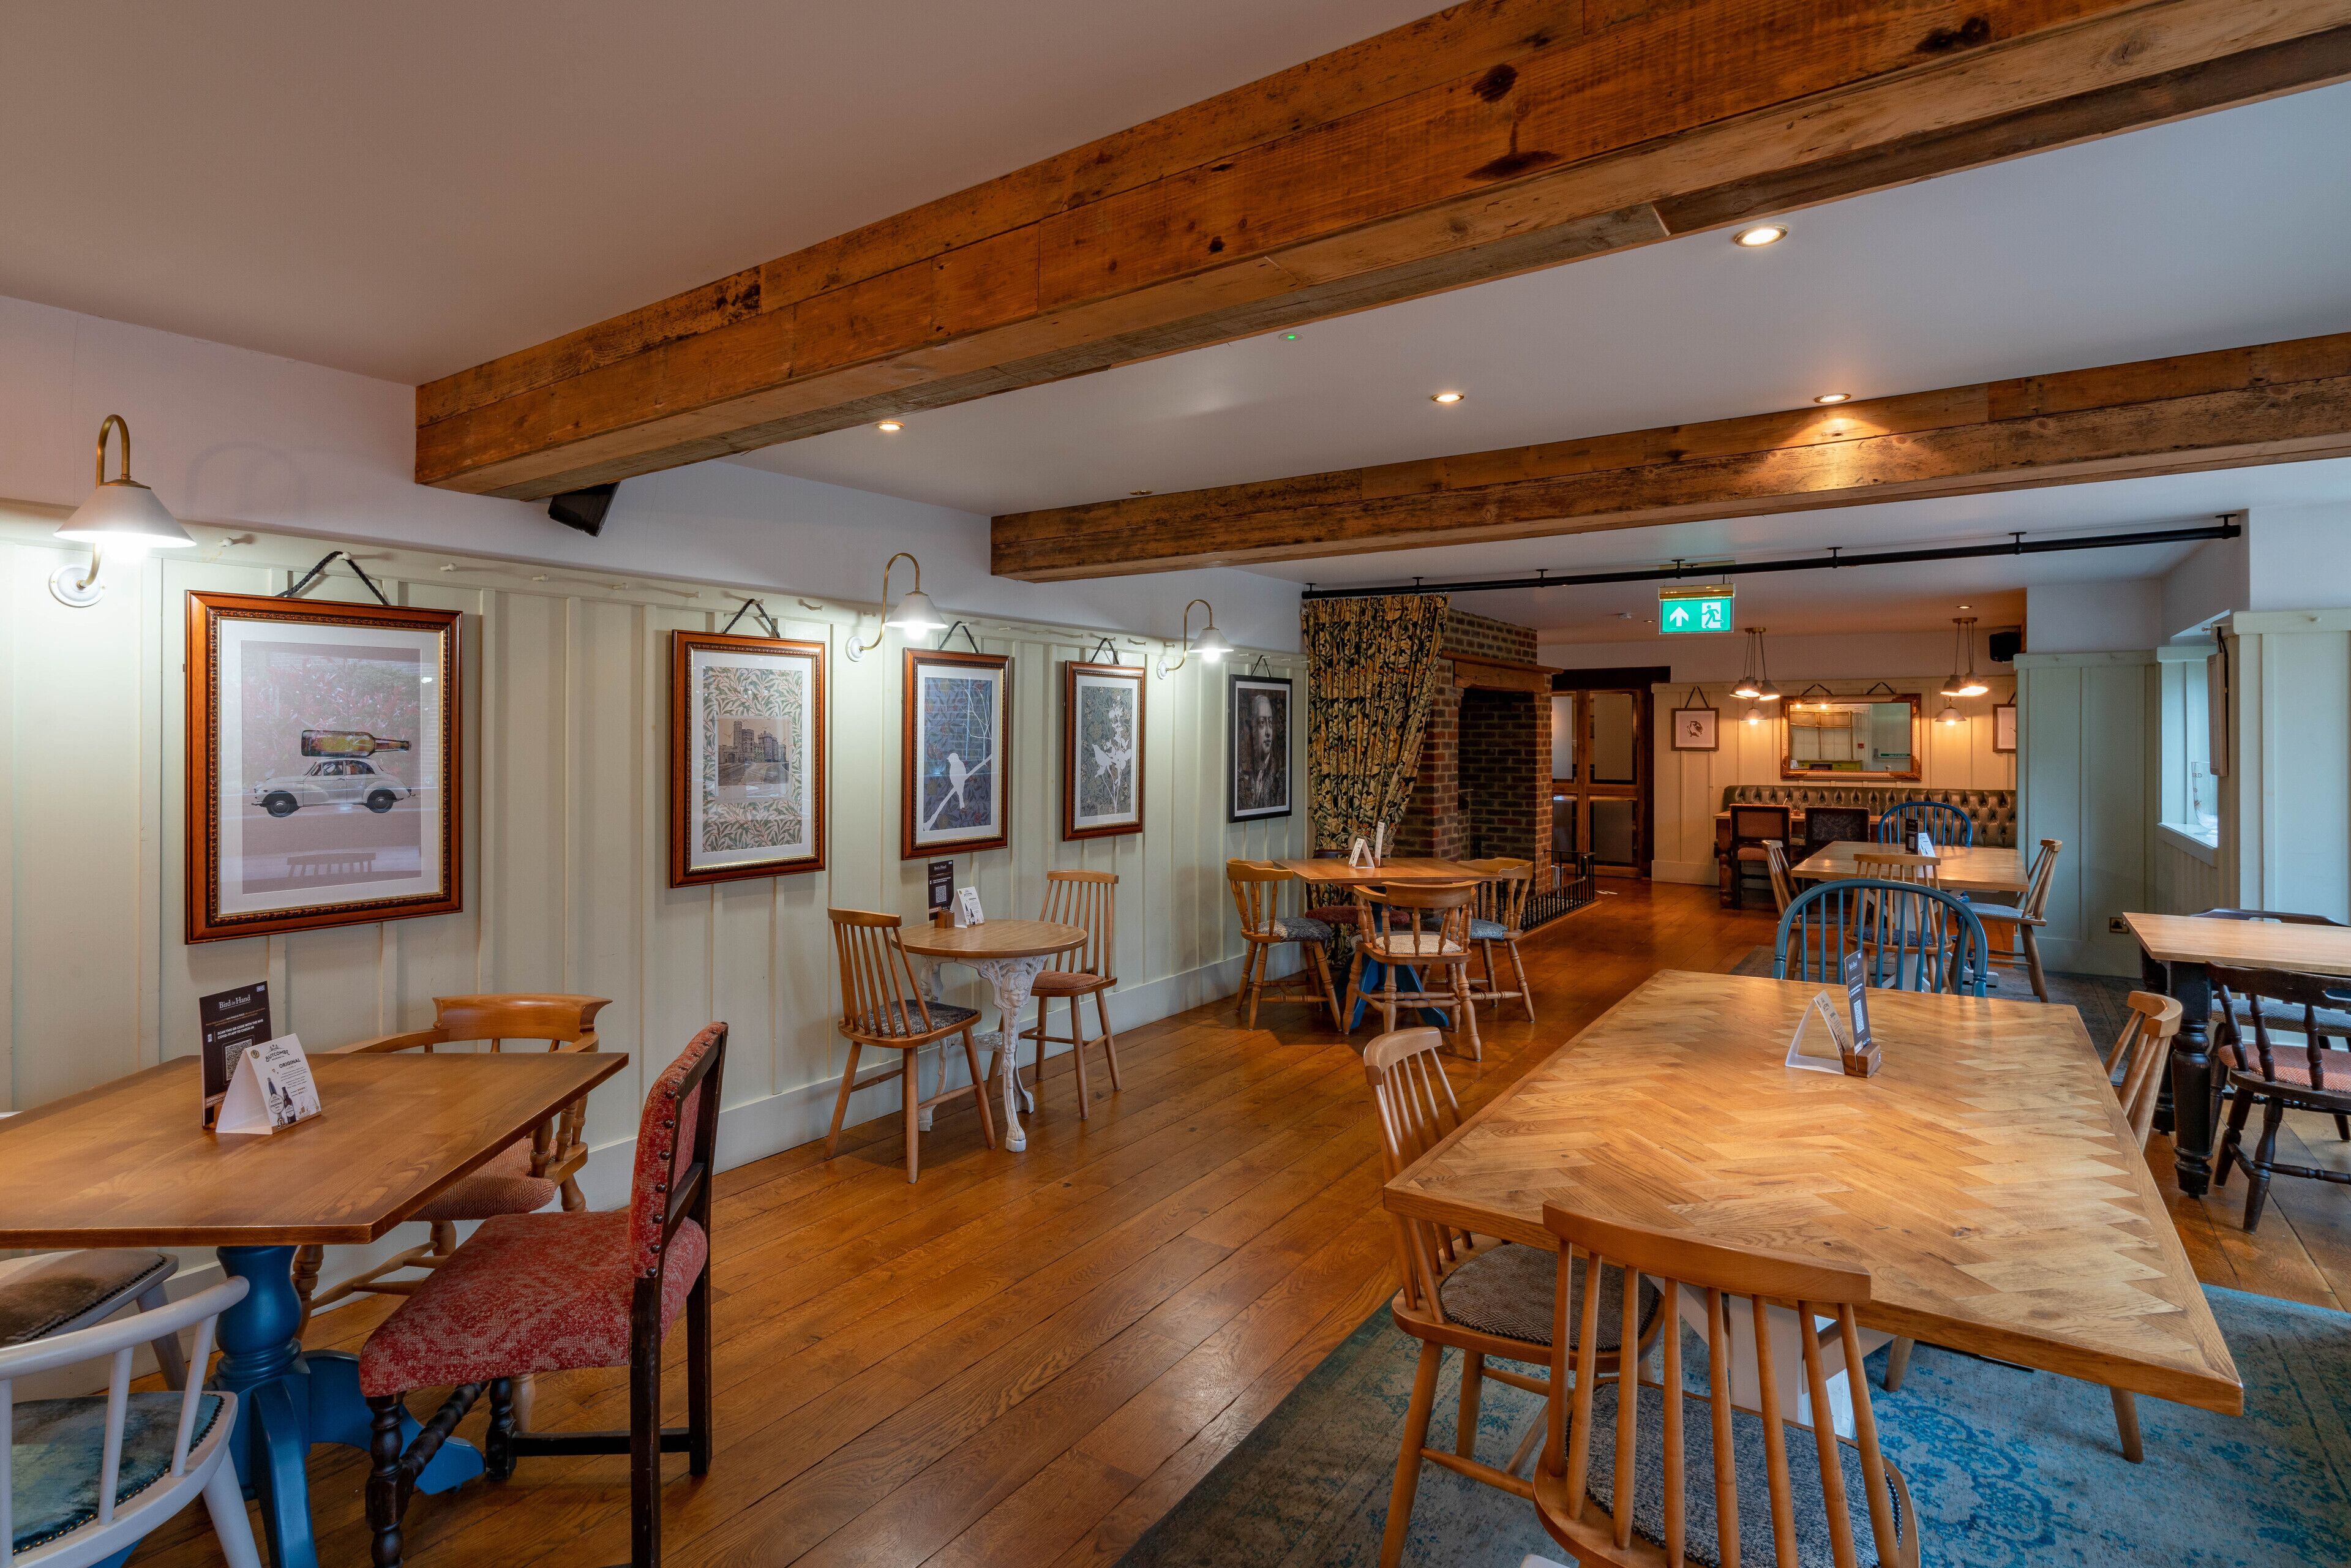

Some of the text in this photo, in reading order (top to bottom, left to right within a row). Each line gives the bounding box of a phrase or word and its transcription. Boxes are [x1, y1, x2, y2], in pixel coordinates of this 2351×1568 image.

[219, 999, 231, 1009] Bird
[235, 994, 251, 1004] Hand
[265, 1049, 290, 1062] BUTCOMBE
[279, 1058, 301, 1068] ORIGINAL
